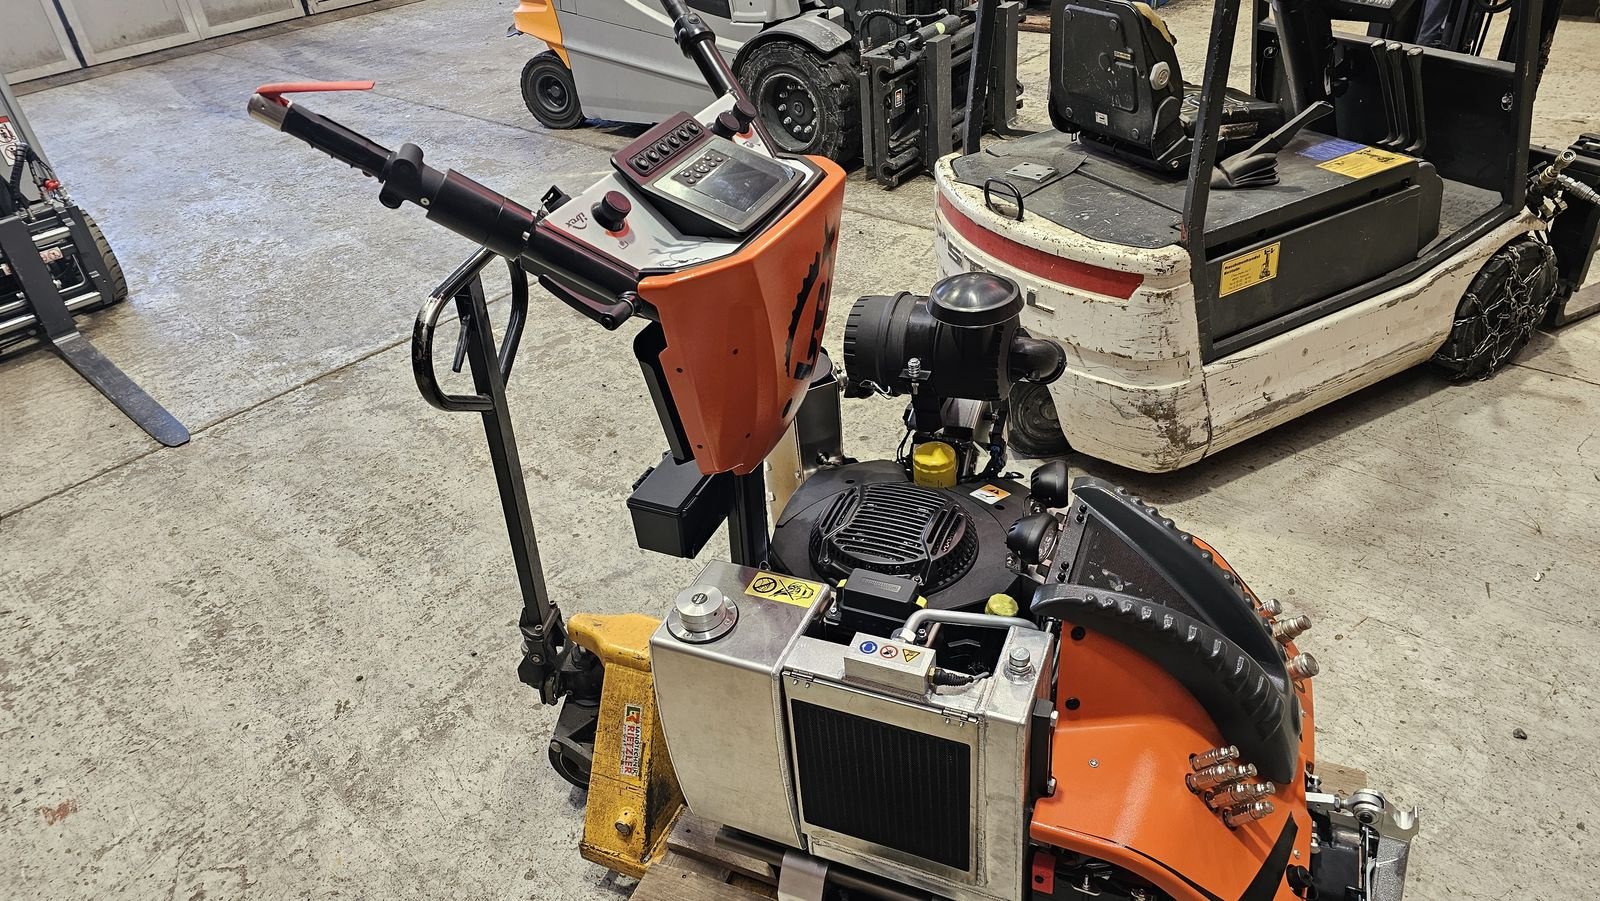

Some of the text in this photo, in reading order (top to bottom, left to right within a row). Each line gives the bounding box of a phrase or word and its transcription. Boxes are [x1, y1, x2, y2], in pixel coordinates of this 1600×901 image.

[947, 239, 1056, 314] STL
[625, 725, 635, 773] RIETZLER
[632, 727, 641, 776] LANDTECHNIK
